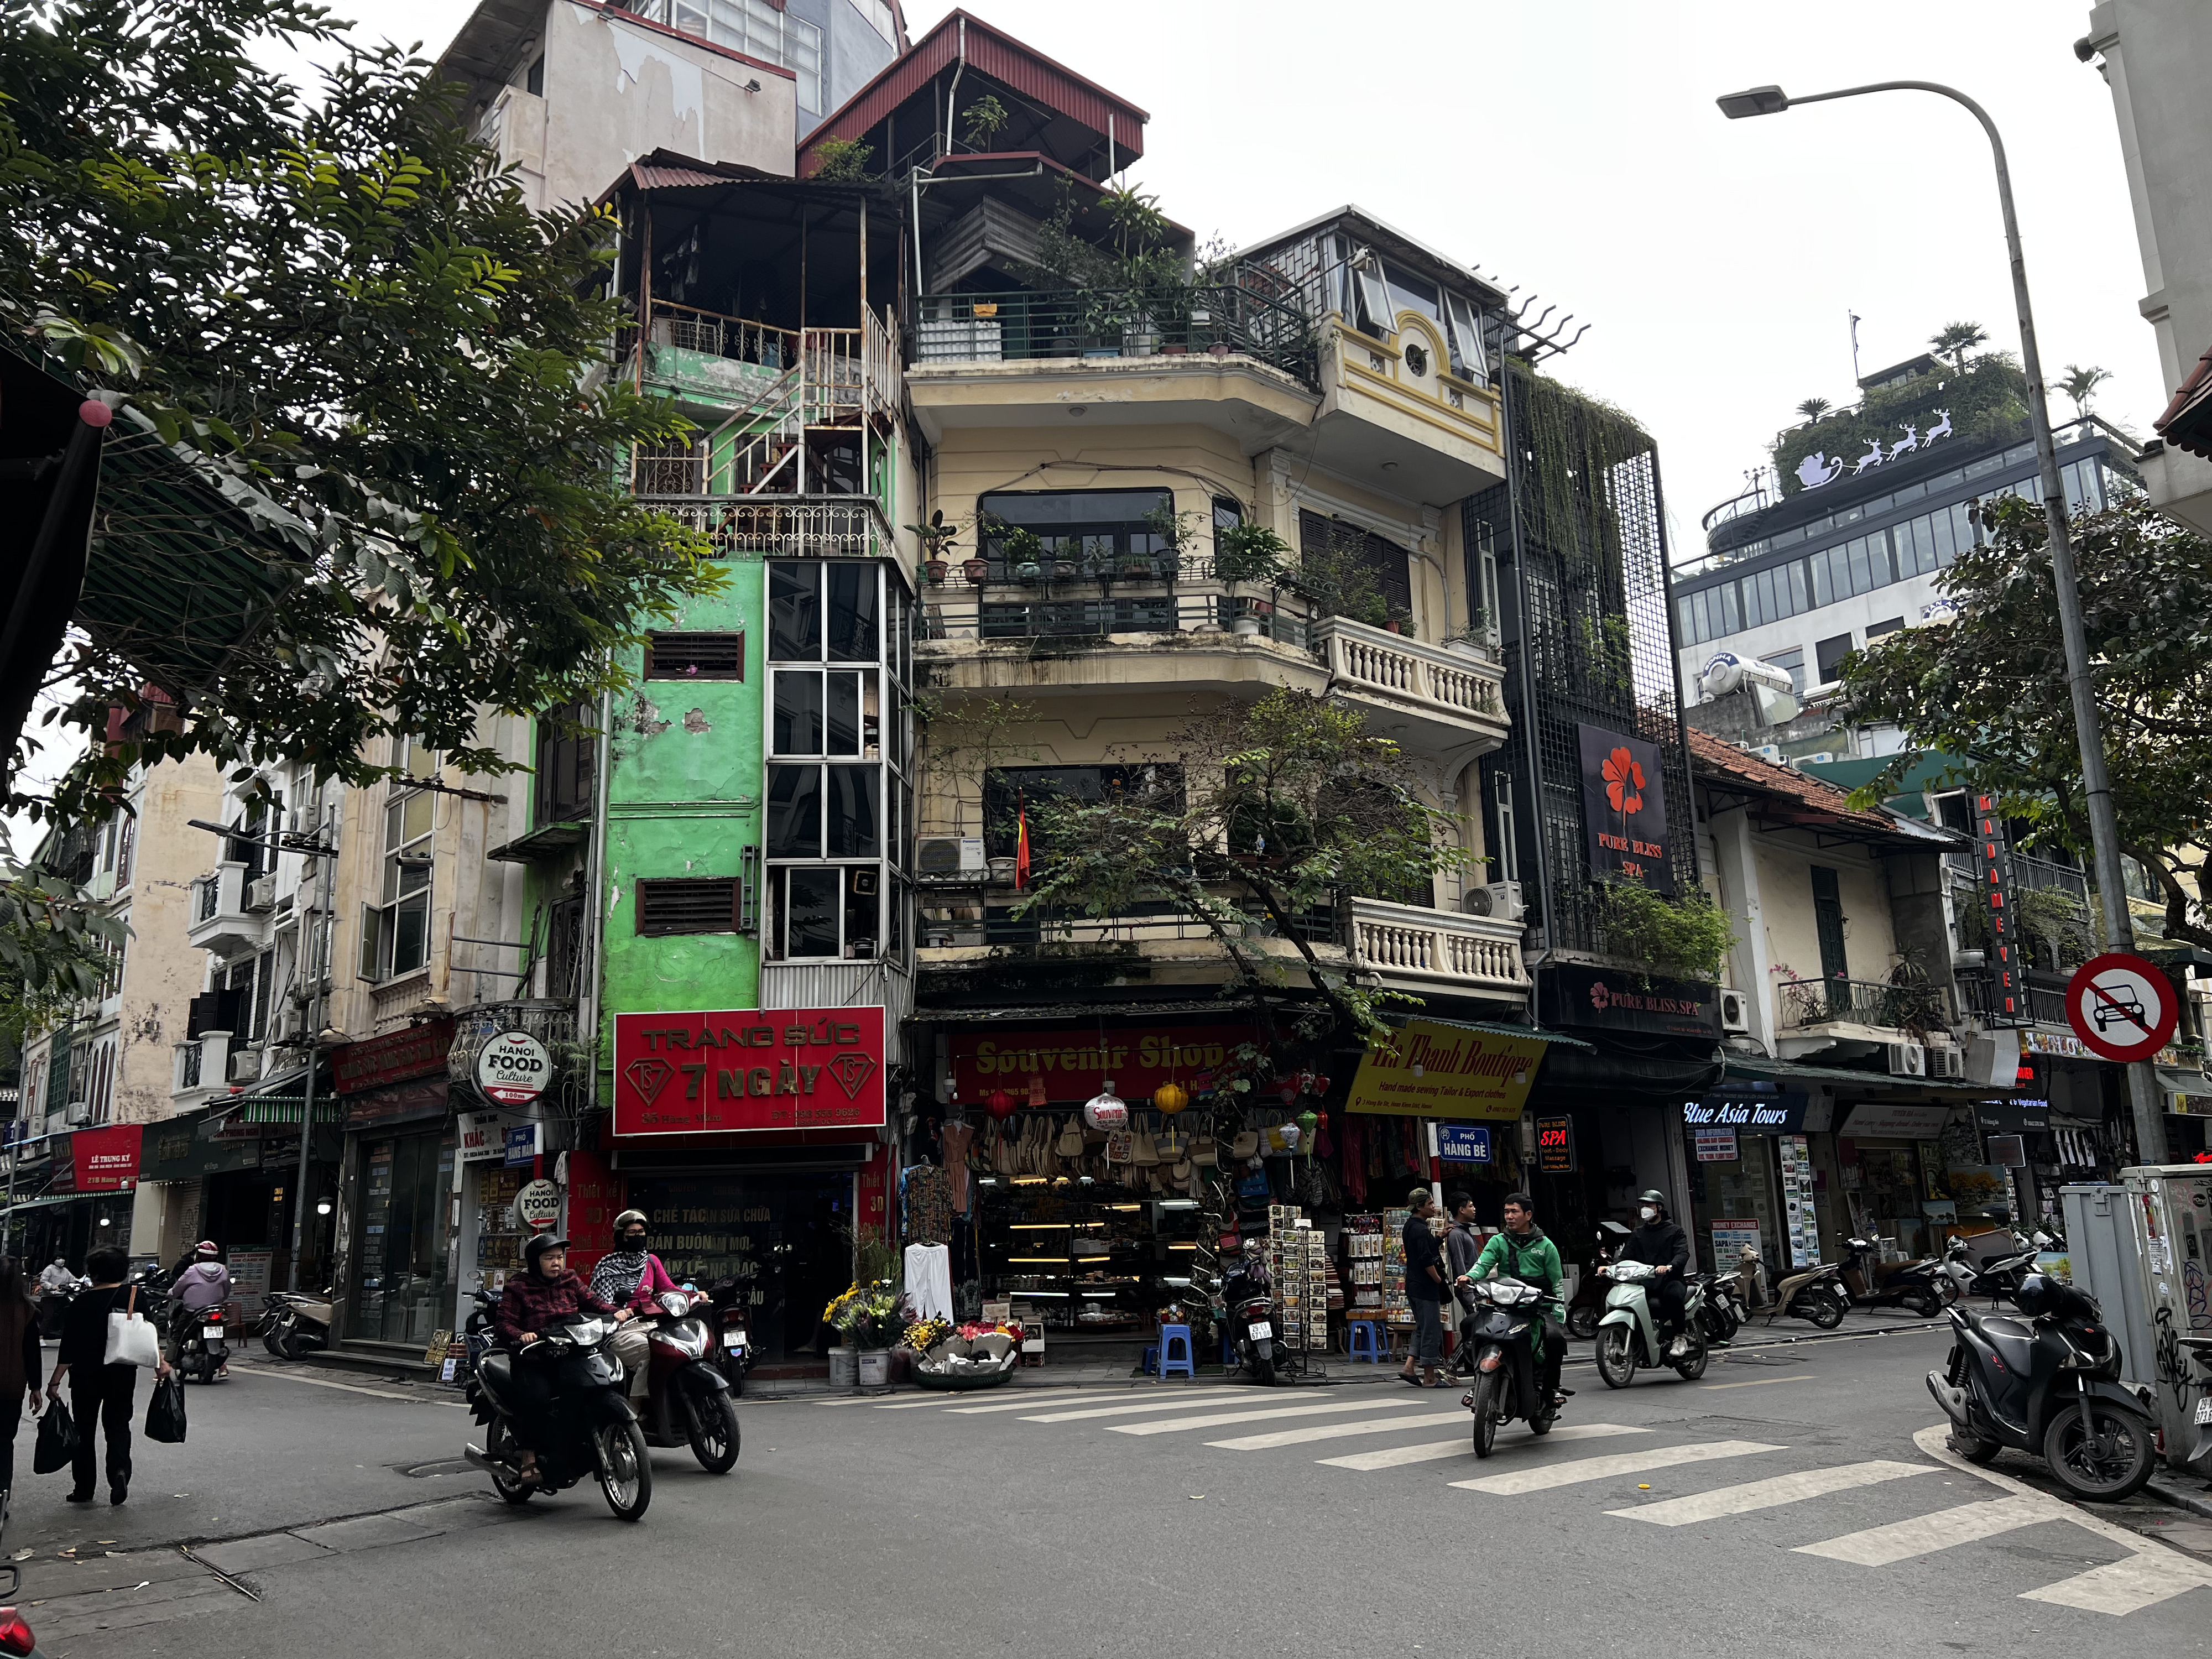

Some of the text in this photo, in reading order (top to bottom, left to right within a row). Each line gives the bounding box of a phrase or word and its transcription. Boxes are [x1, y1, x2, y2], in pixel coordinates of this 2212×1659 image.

[1926, 601, 1942, 613] TAN
[1705, 654, 1731, 671] SONHA
[1598, 833, 1662, 859] PURE BLISS
[1622, 860, 1644, 878] SPA
[1610, 992, 1699, 1016] PURE BLISS SPA
[641, 1017, 860, 1049] TRANG SỨC
[499, 1045, 535, 1057] HANOI
[977, 1035, 1224, 1074] Souvenir Shop
[488, 1055, 542, 1072] FOOD
[1403, 1034, 1462, 1074] Thanh
[1463, 1040, 1533, 1088] Boutique
[496, 1070, 533, 1083] Culture
[681, 1059, 821, 1098] 7 NGÀY
[1379, 1081, 1506, 1099] Hand made sewing Tailor & Export clothes
[2017, 1098, 2038, 1108] Vegetarian
[641, 1112, 658, 1124] 35
[1683, 1102, 1788, 1124] Blue Asia Tours
[464, 1126, 484, 1149] KHẮC
[515, 1131, 526, 1142] PHỐ
[1460, 1130, 1475, 1140] PHỐ
[1541, 1130, 1566, 1145] SPA
[508, 1144, 521, 1160] HÀNG
[1444, 1141, 1486, 1157] HÀNG BÈ
[862, 1171, 880, 1188] Thiết
[524, 1197, 560, 1209] FOOD
[870, 1196, 884, 1212] 3D
[529, 1209, 556, 1219] Culture
[653, 1203, 706, 1223] CHẾ TÁC
[646, 1232, 712, 1250] BÁN BUÔN
[1531, 1248, 1545, 1256] Gra
[664, 1258, 682, 1274] ÁN
